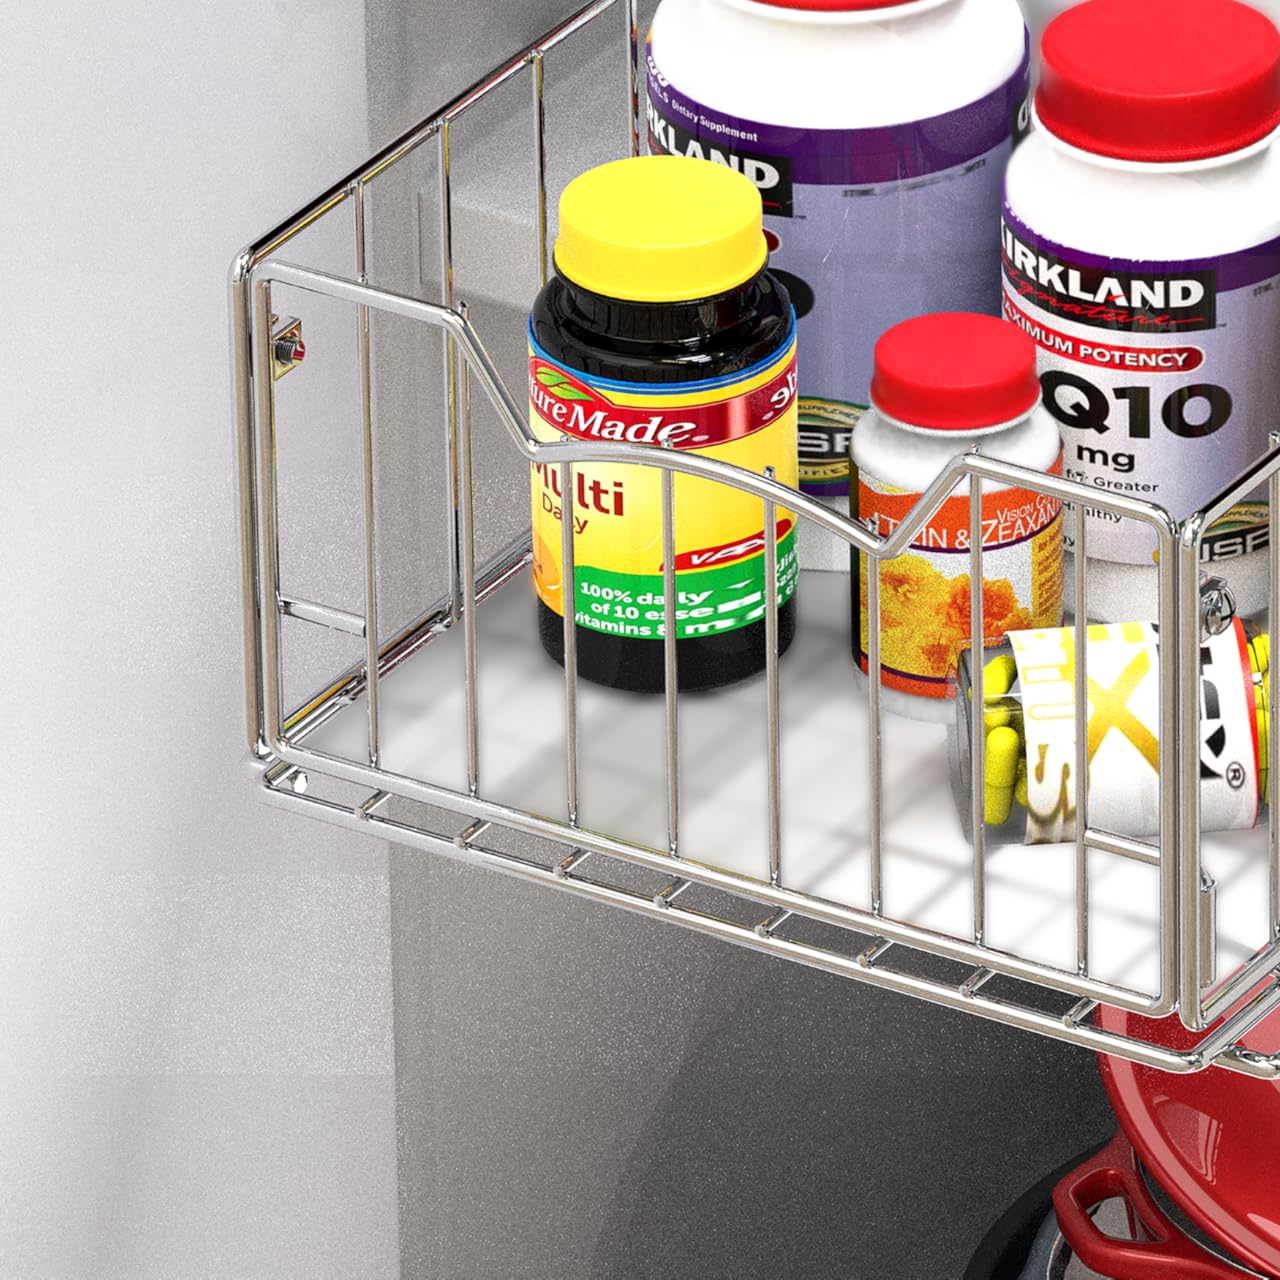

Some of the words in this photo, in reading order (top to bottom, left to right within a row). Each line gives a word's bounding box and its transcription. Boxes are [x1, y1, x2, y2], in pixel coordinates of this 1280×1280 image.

[671, 99, 699, 124] Dietary
[699, 115, 759, 143] Supplement
[1003, 297, 1074, 355] AXIMUM
[1079, 345, 1190, 367] POTENCY
[1076, 443, 1136, 473] mg
[1093, 476, 1160, 493] Greater
[543, 492, 589, 535] Day
[954, 529, 971, 550] &
[580, 581, 632, 604] 100%
[637, 589, 715, 606] daly
[591, 603, 611, 615] of
[613, 605, 640, 620] 10
